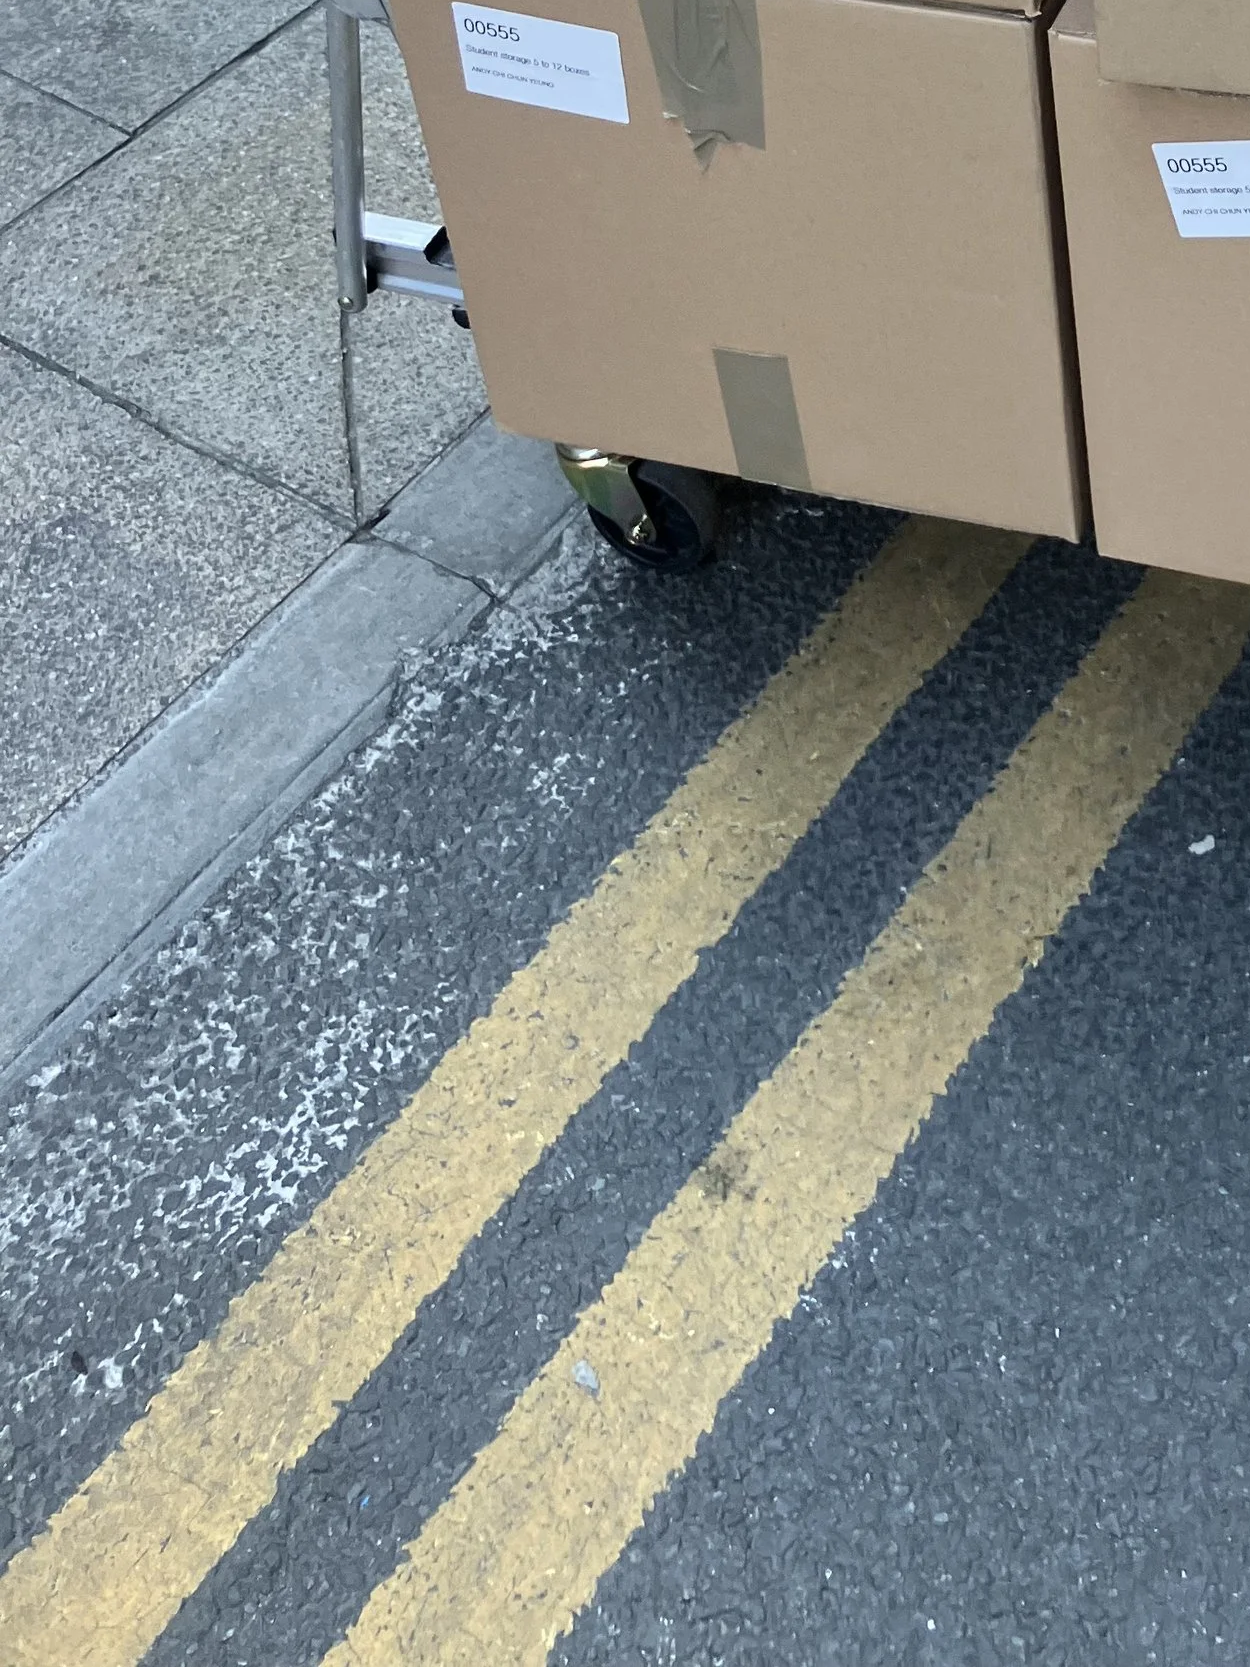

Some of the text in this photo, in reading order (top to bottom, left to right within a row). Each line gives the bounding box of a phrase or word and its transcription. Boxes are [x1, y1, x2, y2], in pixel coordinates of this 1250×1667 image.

[464, 18, 520, 41] 00555
[466, 44, 498, 58] Student
[501, 51, 530, 65] storage
[541, 60, 549, 68] to
[553, 62, 562, 70] 12
[565, 65, 590, 76] boxes
[1167, 157, 1227, 173] 00555
[1173, 186, 1208, 195] Student
[1210, 186, 1243, 195] storage
[1245, 185, 1250, 193] 5
